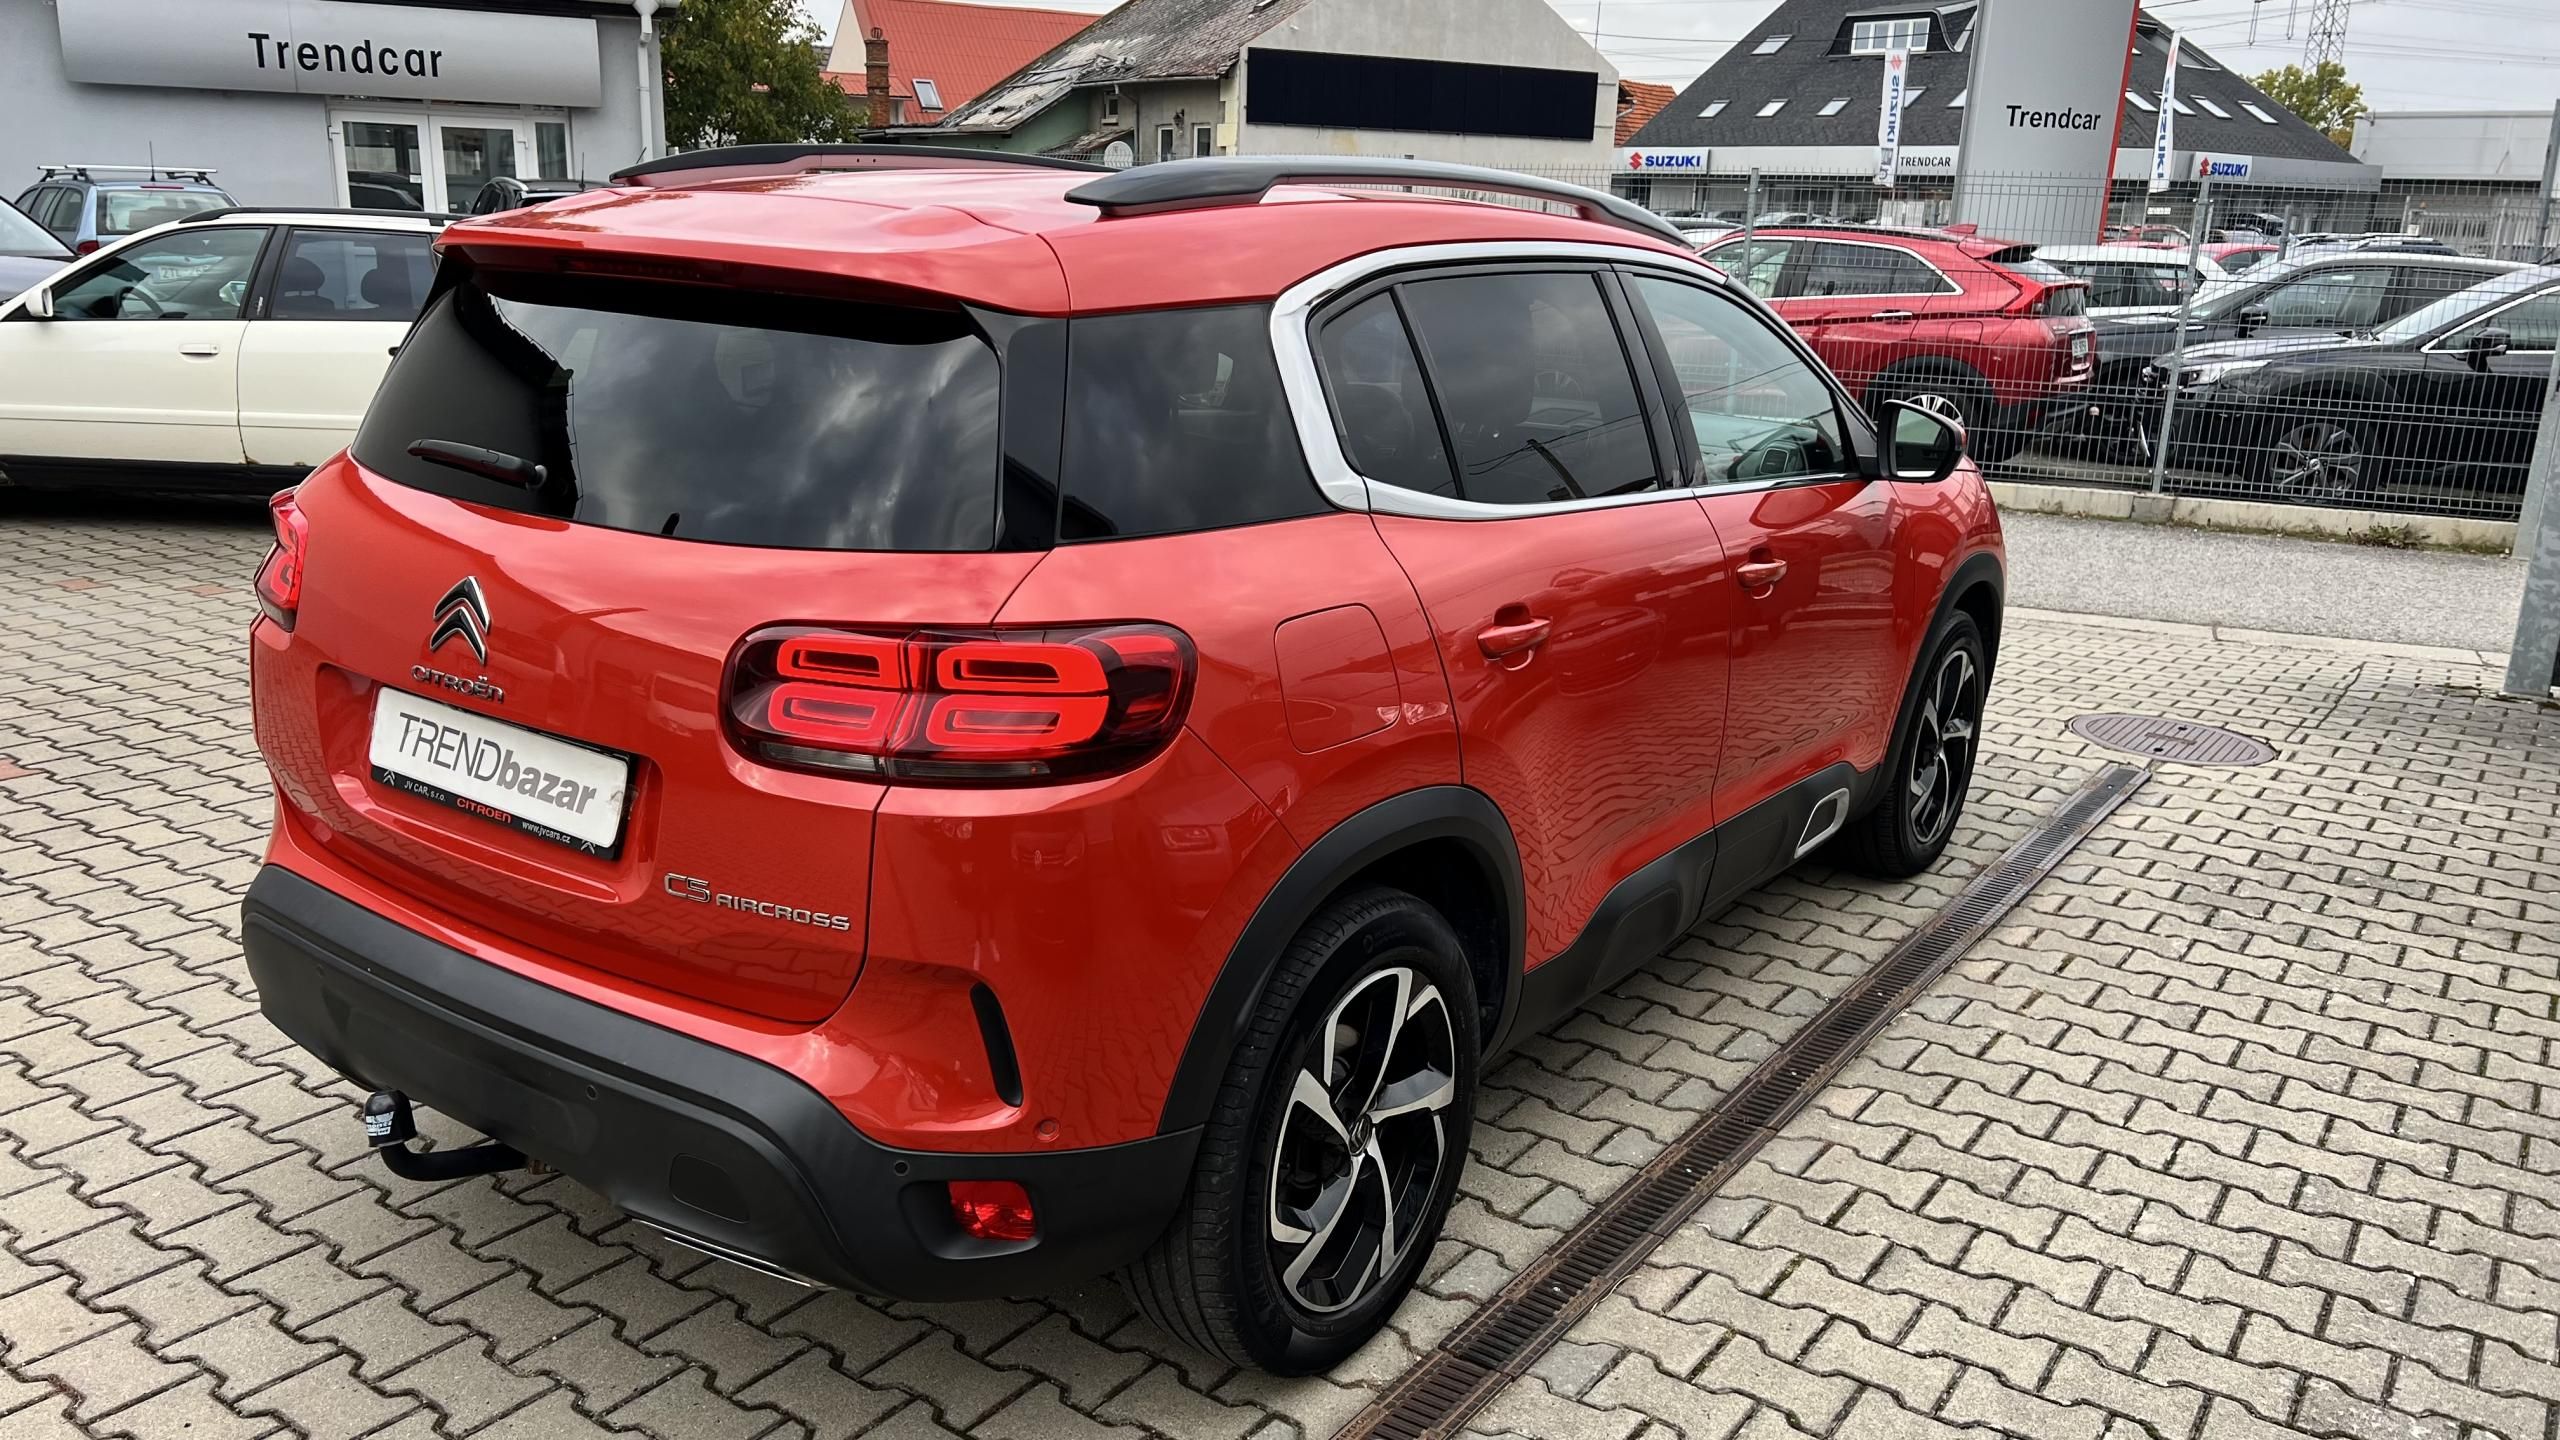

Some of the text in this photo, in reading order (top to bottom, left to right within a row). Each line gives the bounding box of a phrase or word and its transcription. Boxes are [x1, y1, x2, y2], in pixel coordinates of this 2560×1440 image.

[248, 33, 442, 77] Trendcar
[2006, 105, 2101, 130] Trendcar
[1645, 155, 1701, 167] SUZUKI
[1900, 156, 1951, 167] TRENDCAR
[2210, 162, 2248, 177] SUZUKI
[399, 712, 597, 815] TRENDbazar
[404, 780, 413, 790] JV
[522, 821, 571, 844] www.jvcars.cz
[664, 872, 850, 931] C5 AIRCROSS
